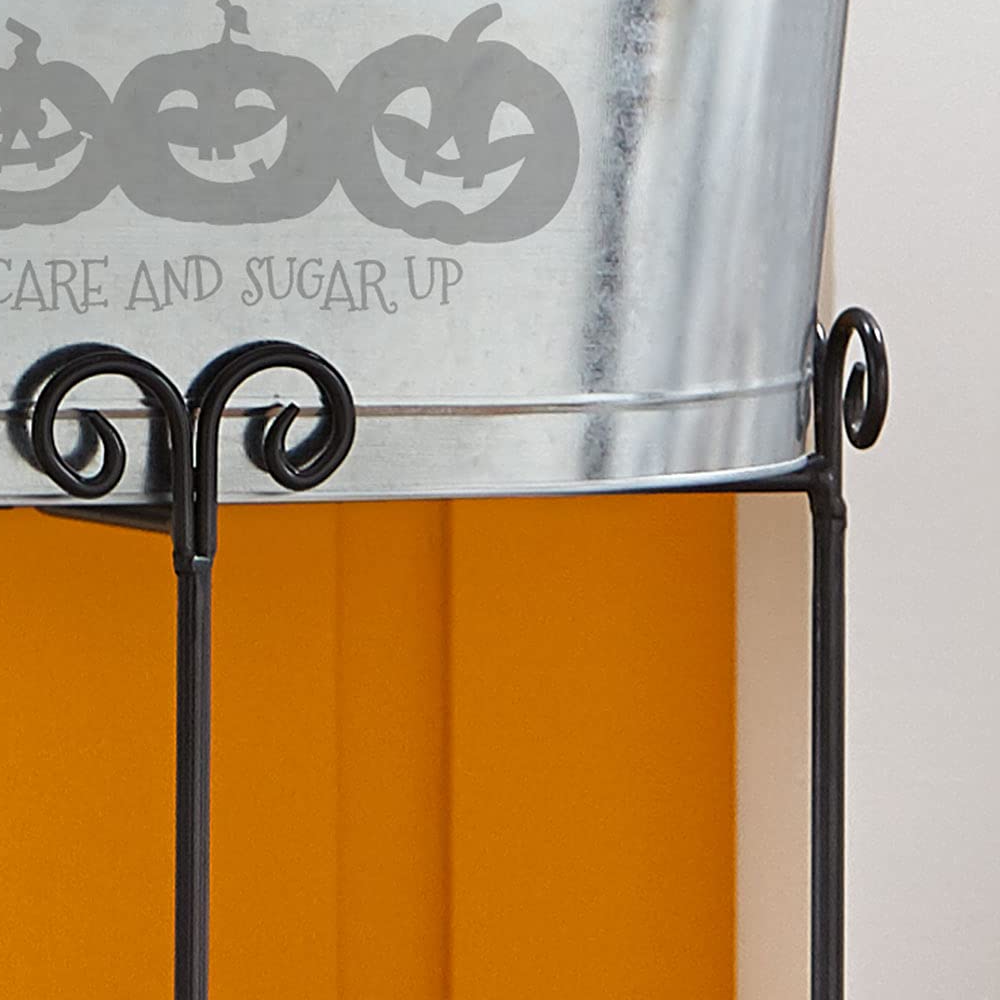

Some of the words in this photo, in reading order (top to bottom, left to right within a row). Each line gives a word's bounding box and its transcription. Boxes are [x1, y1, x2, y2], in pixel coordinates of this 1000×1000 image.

[124, 254, 223, 312] AND
[240, 255, 399, 315] SUGAR
[403, 255, 464, 305] UP
